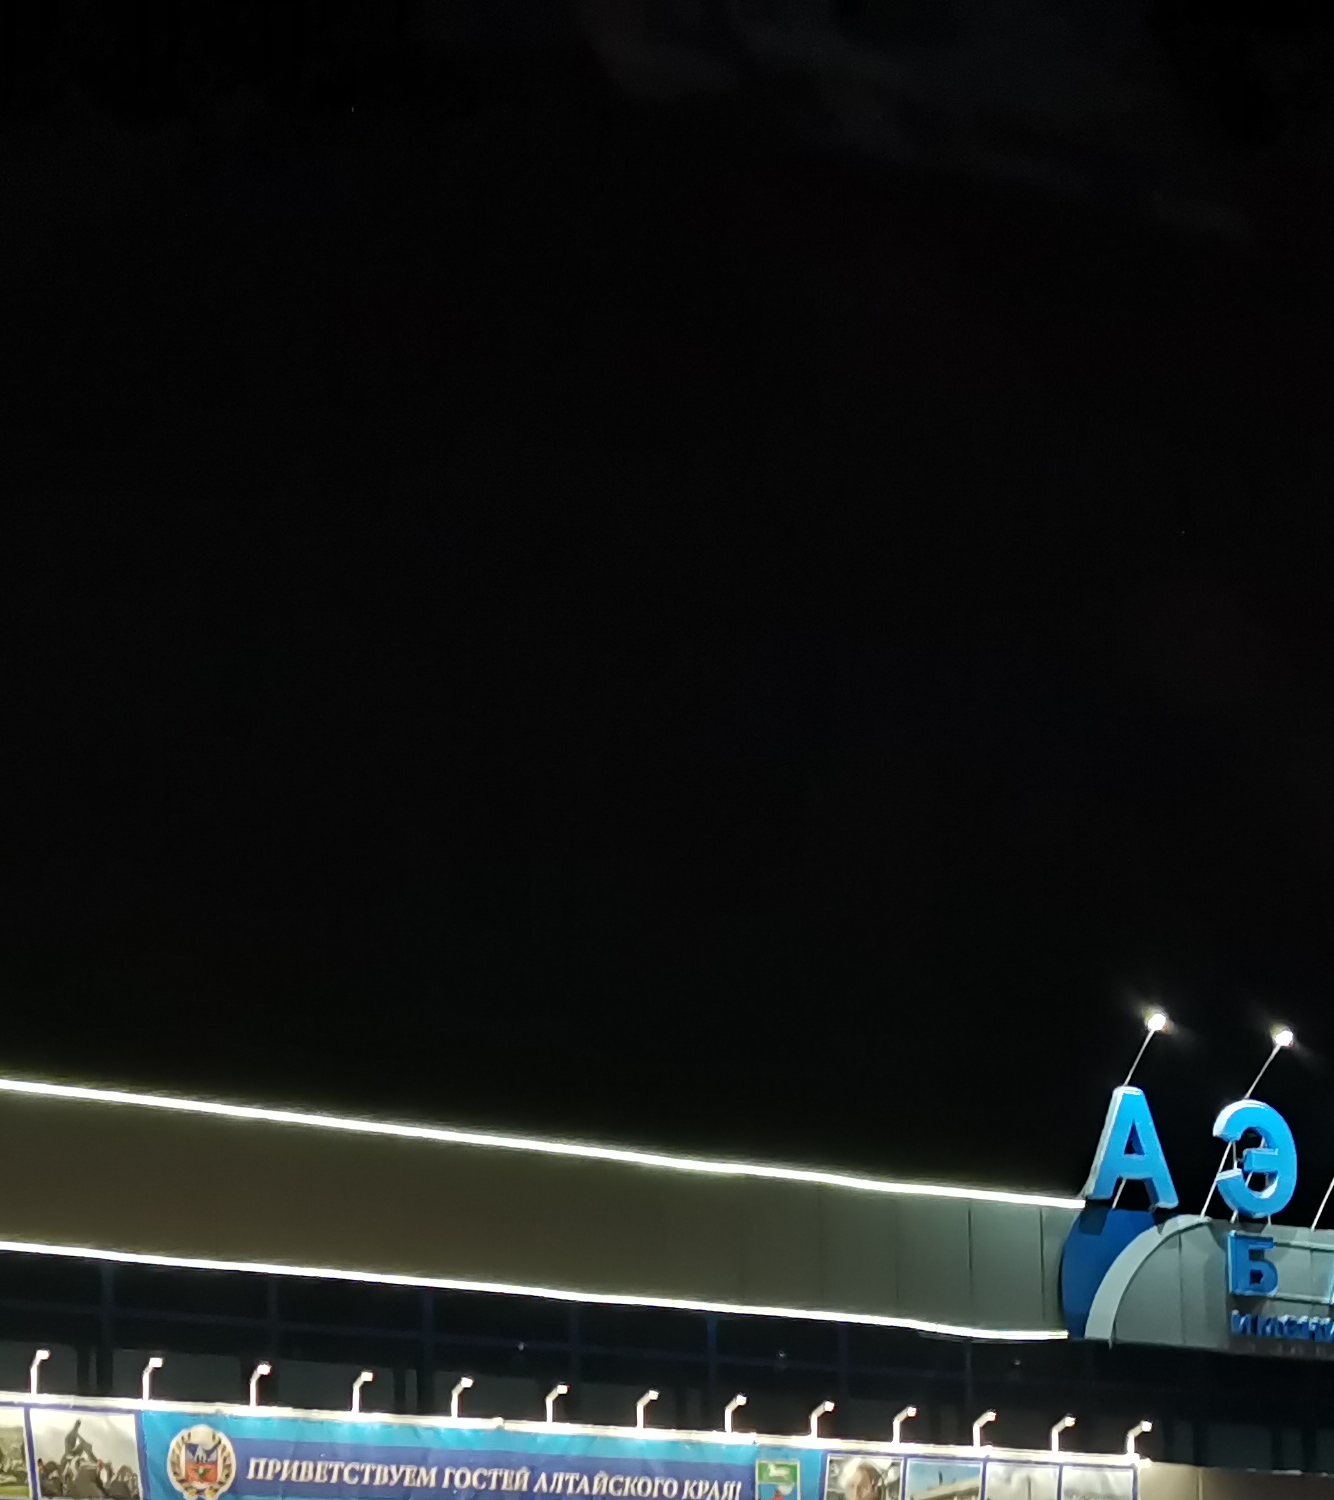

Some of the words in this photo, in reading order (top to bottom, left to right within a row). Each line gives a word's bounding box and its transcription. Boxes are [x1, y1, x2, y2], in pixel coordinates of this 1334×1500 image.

[246, 1457, 437, 1489] ПРИВЕТСТВУЕМ
[442, 1465, 529, 1493] ГОСТЕЙ
[533, 1470, 678, 1500] АЛТАЙСКОГО
